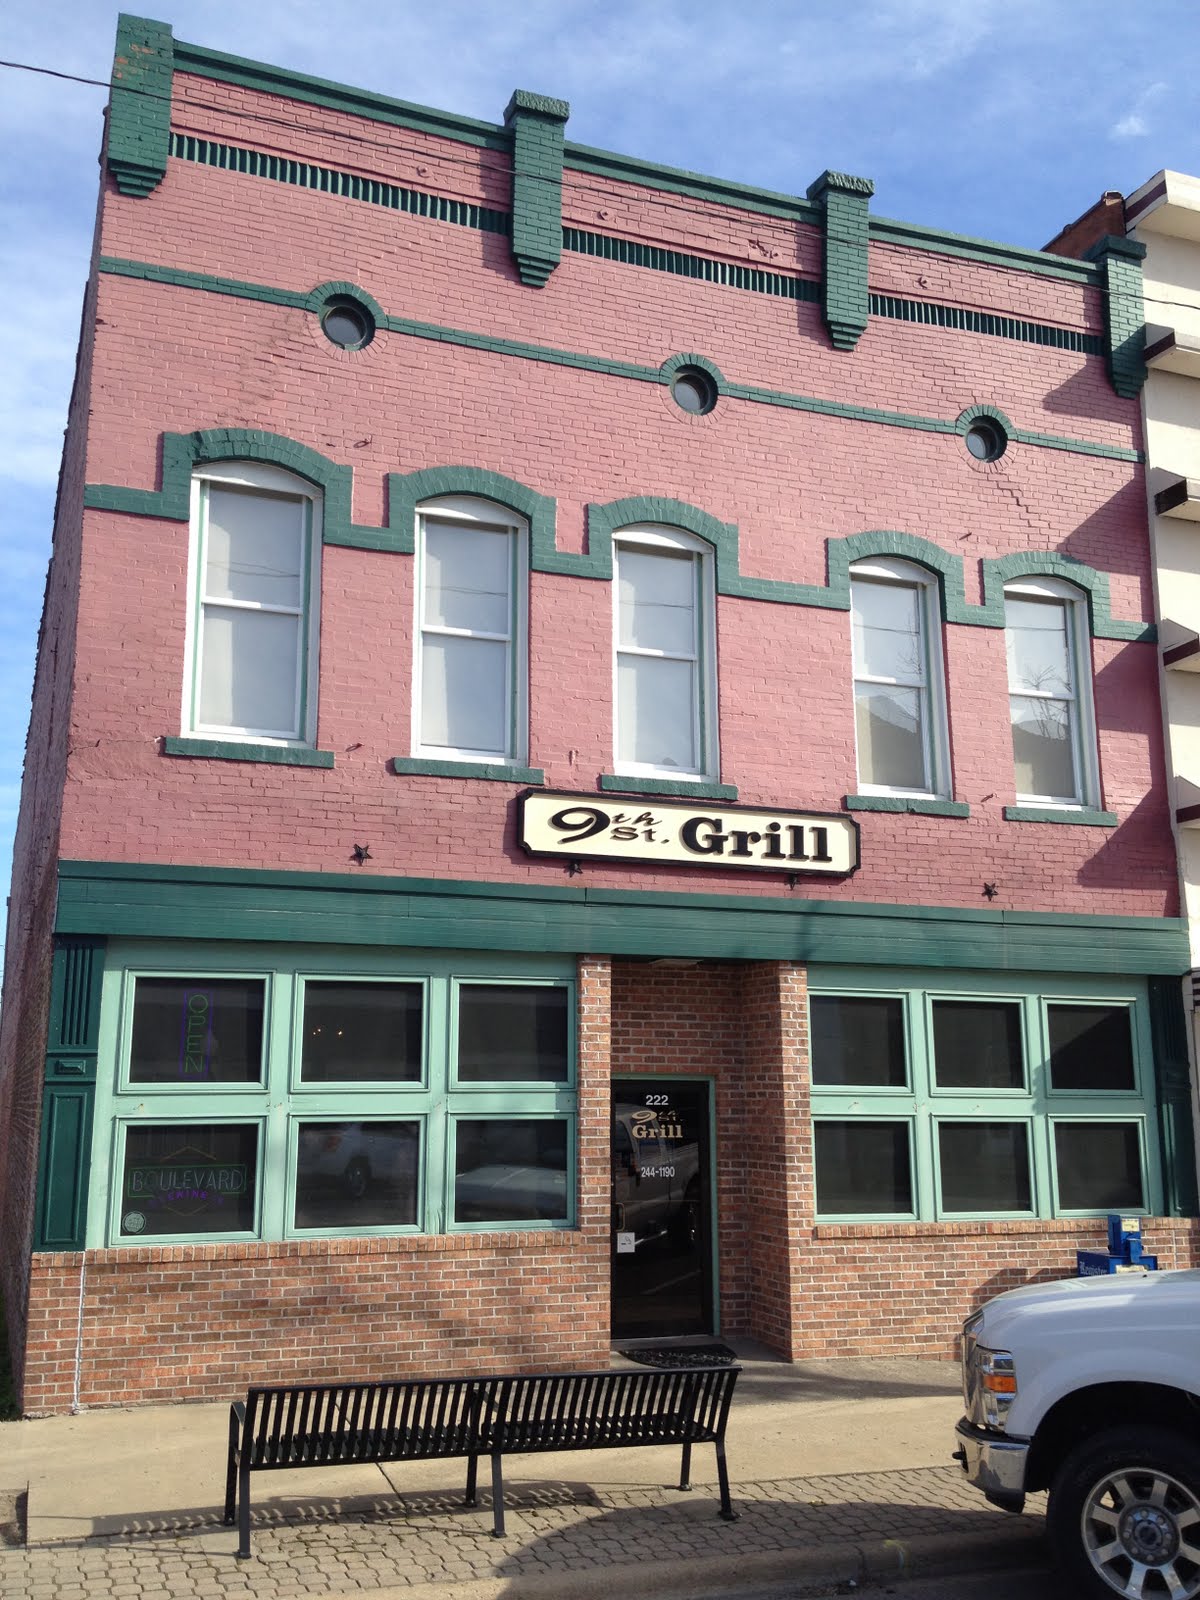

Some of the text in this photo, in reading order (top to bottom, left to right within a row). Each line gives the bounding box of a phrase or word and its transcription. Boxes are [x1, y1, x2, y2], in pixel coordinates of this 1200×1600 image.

[552, 807, 832, 862] 9th St. Grill
[184, 994, 208, 1073] OPEN
[645, 1094, 669, 1106] 222
[632, 1124, 684, 1139] Grill
[132, 1169, 243, 1192] BOULEVARD
[641, 1166, 675, 1178] 244-1190
